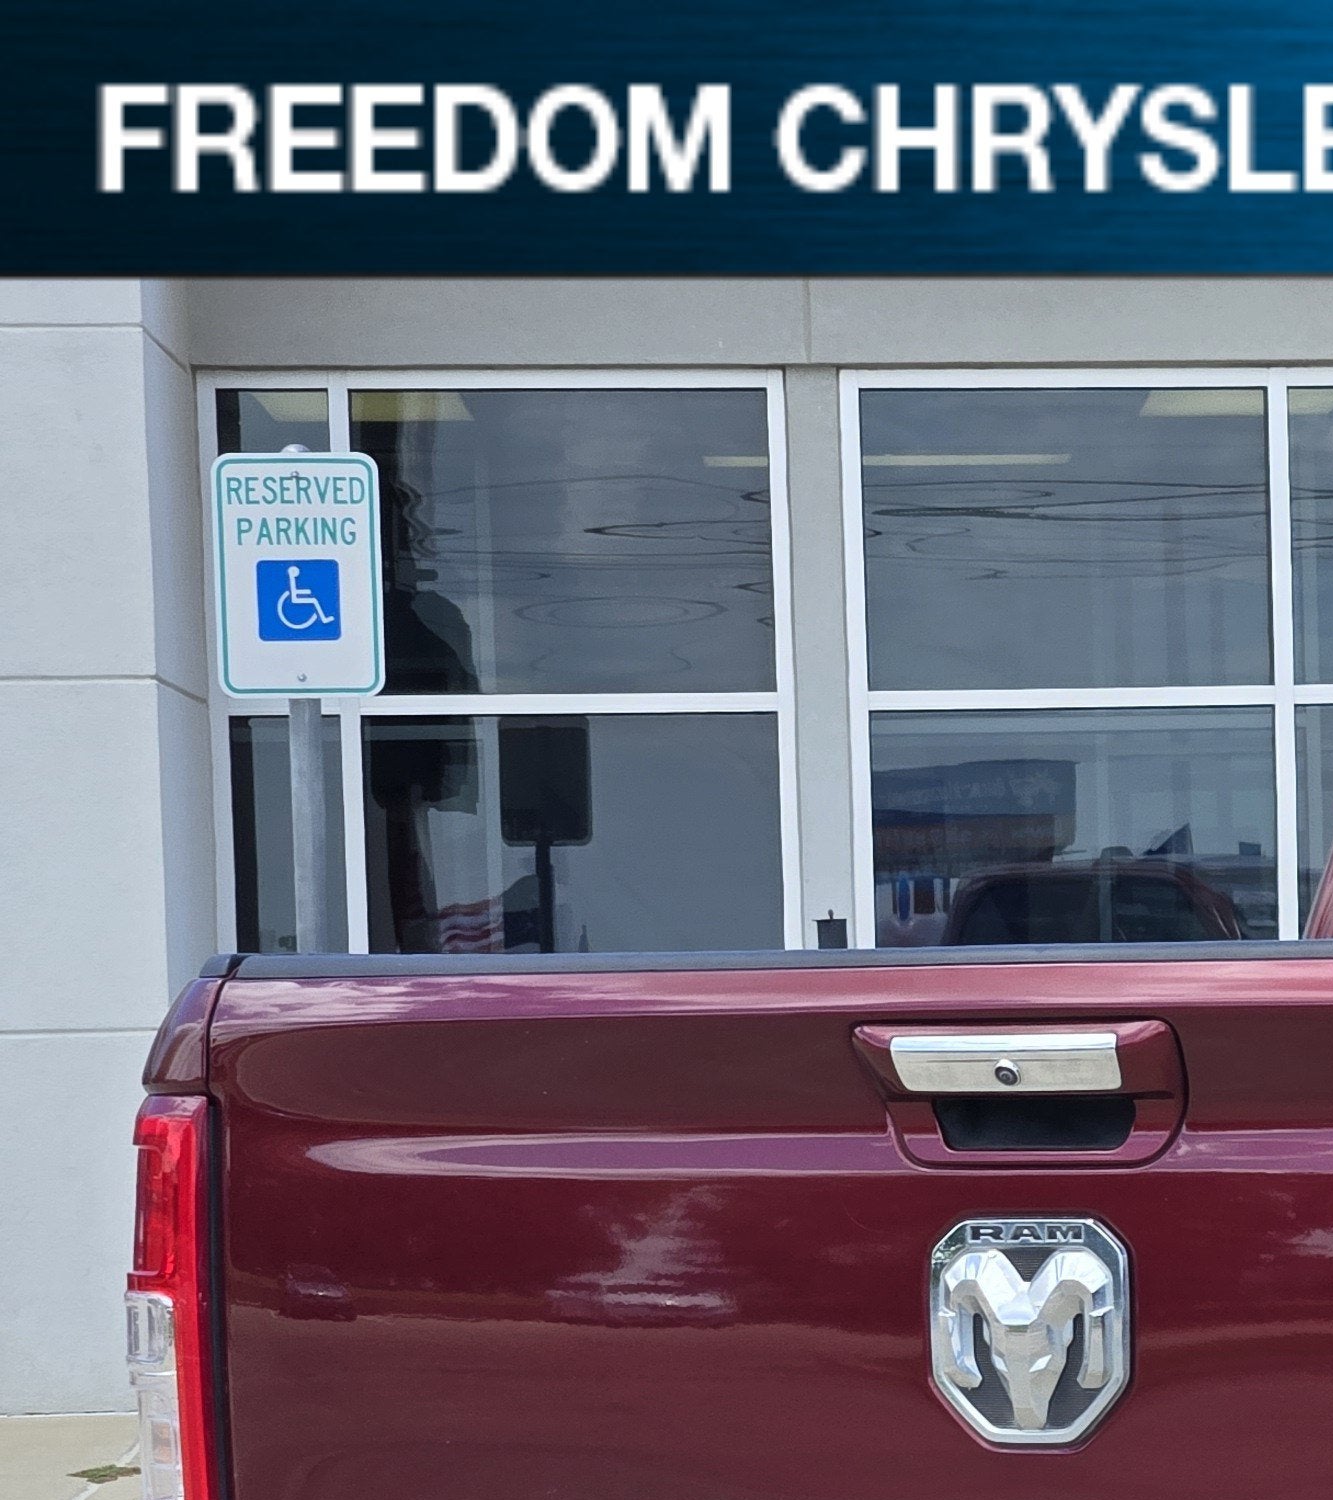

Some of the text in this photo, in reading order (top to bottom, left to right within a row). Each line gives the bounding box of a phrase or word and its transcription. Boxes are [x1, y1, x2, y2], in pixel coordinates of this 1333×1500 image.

[225, 475, 366, 505] RESERVED
[236, 516, 358, 546] PARKING
[968, 1224, 1086, 1244] RAM
